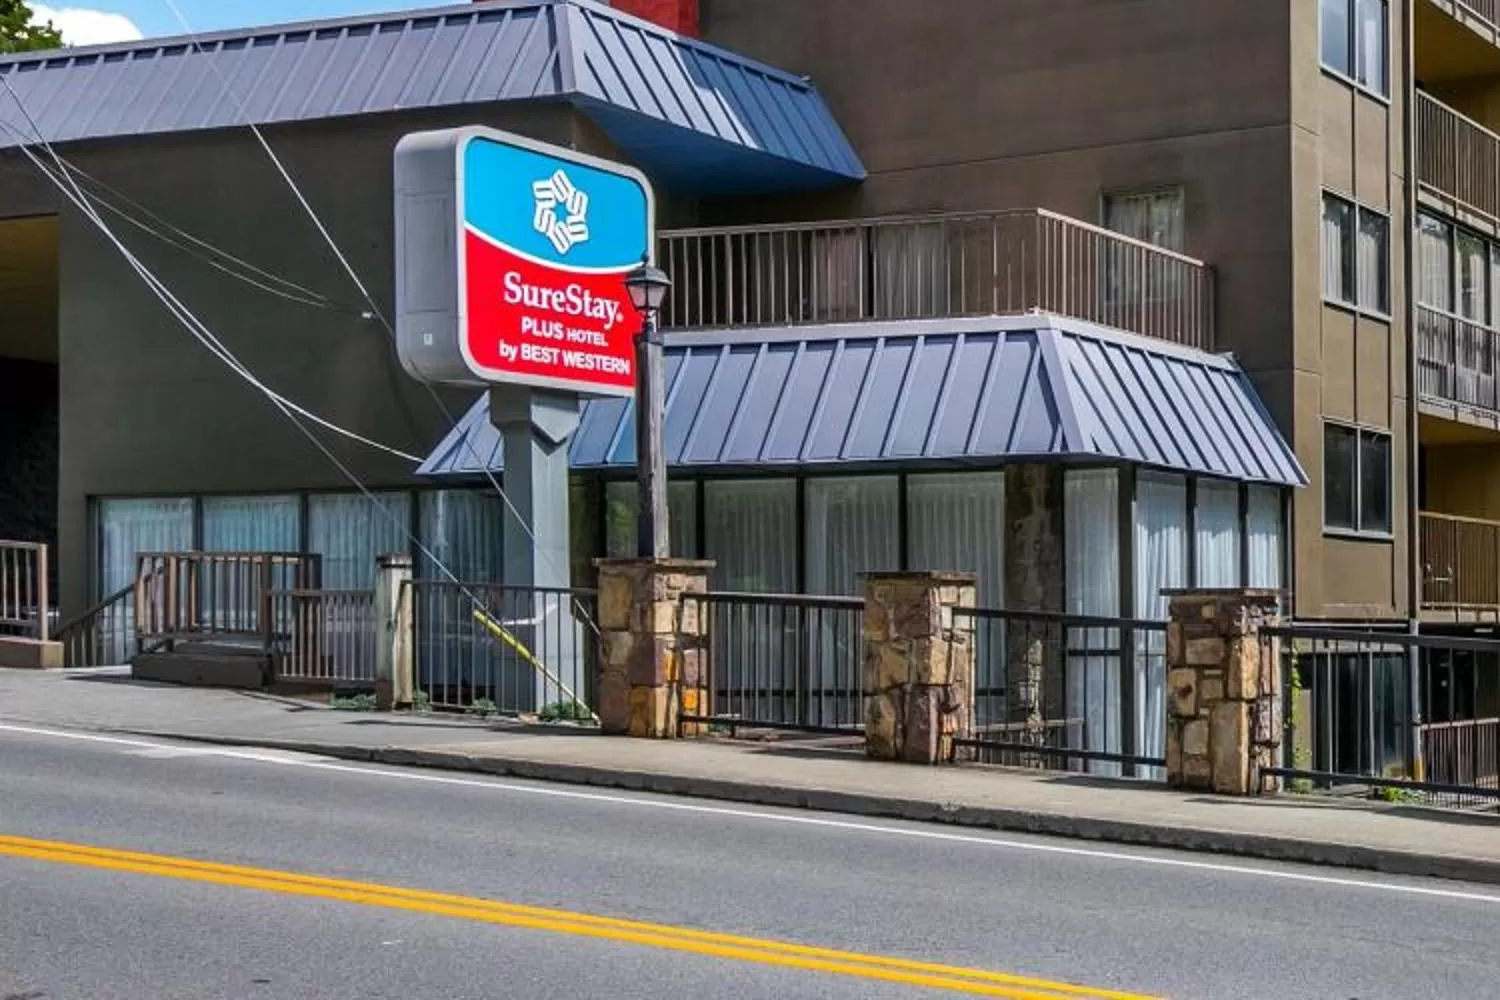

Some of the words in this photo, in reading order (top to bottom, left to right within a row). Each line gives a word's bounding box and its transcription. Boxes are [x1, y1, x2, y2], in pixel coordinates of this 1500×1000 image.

[503, 271, 621, 329] SureStay
[522, 317, 564, 339] PLUS
[566, 328, 608, 347] HOTEL
[499, 339, 517, 362] by
[521, 343, 560, 365] BEST
[563, 352, 631, 375] WESTERN
